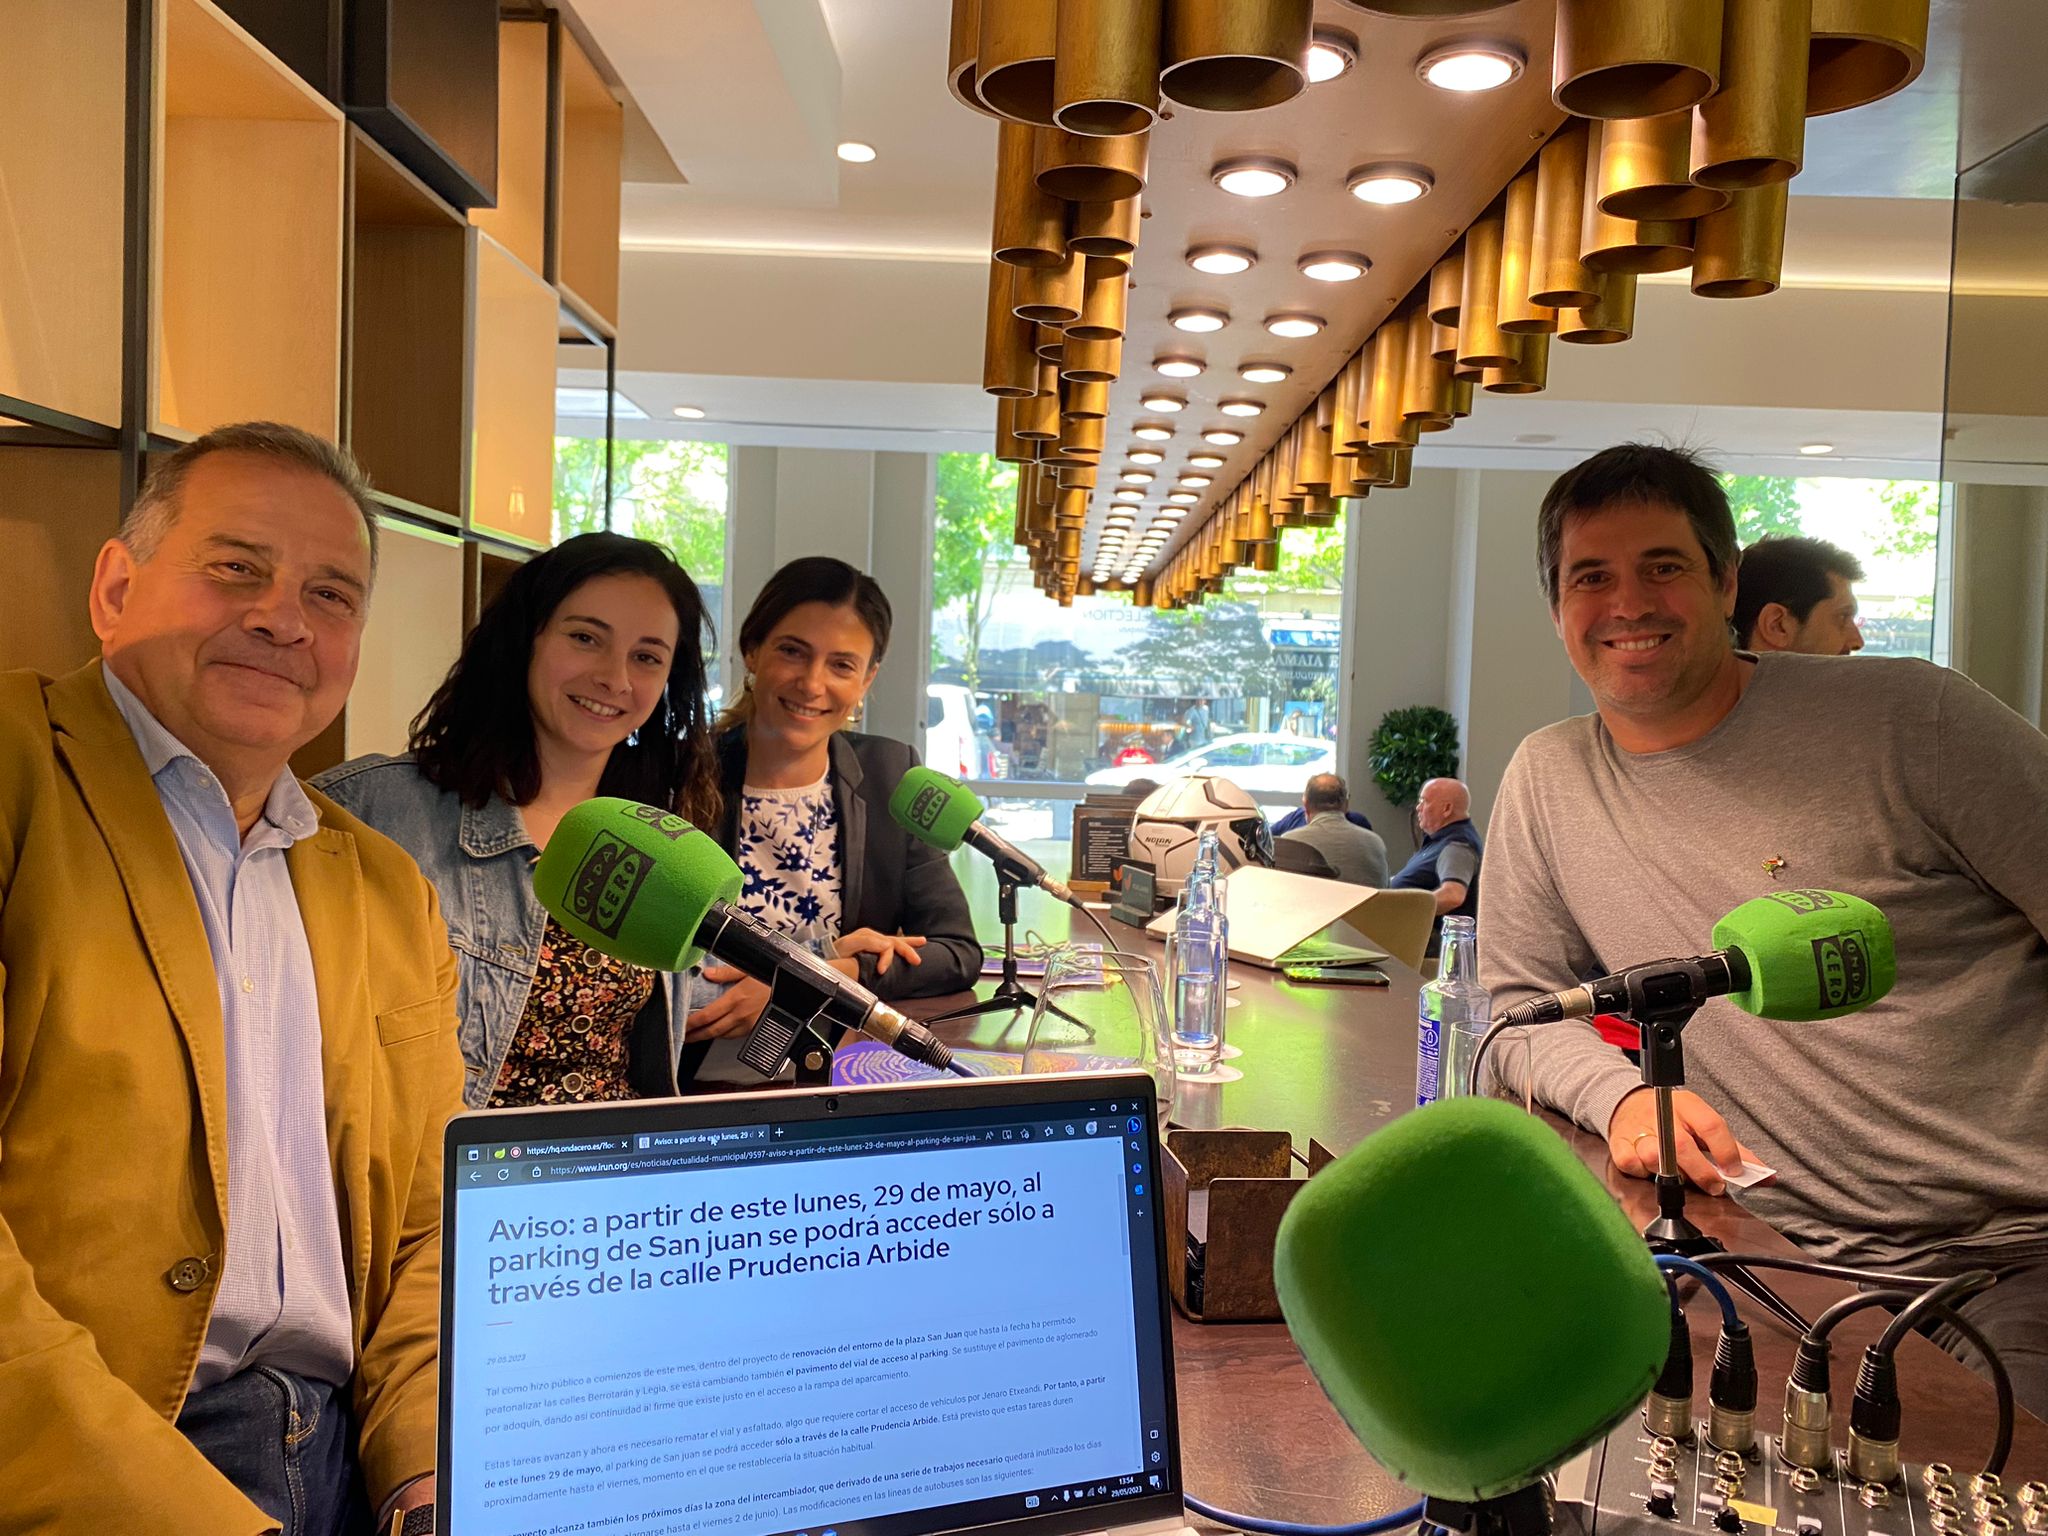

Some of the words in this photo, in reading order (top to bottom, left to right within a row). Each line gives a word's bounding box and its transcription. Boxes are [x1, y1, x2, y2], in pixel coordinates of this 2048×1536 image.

[1274, 653, 1323, 667] AMAIA
[912, 789, 932, 818] ONDA
[924, 795, 943, 822] CERO
[1145, 836, 1173, 845] NOLAN
[577, 850, 612, 909] ONDA
[600, 860, 635, 919] CERO
[1826, 950, 1842, 1002] CERO
[1847, 943, 1861, 996] ONDA
[488, 1215, 574, 1242] Aviso:
[582, 1216, 597, 1233] a
[606, 1204, 683, 1237] partir
[690, 1201, 723, 1223] de
[730, 1197, 787, 1219] este
[794, 1193, 866, 1214] lunes,
[874, 1184, 903, 1206] 29
[910, 1181, 940, 1202] de
[946, 1179, 1016, 1202] mayo,
[1022, 1171, 1040, 1192] al
[489, 1243, 598, 1280] parking
[606, 1238, 642, 1261] de
[648, 1235, 699, 1257] San
[707, 1230, 761, 1258] juan
[768, 1228, 797, 1246] se
[804, 1213, 879, 1248] podrá
[885, 1207, 982, 1234] acceder
[988, 1201, 1036, 1224] sólo
[1041, 1203, 1054, 1218] a
[487, 1274, 580, 1304] través
[587, 1271, 622, 1294] de
[630, 1268, 652, 1290] la
[659, 1260, 721, 1286] calle
[728, 1248, 860, 1279] Prudencia
[866, 1238, 950, 1265] Arbide
[698, 1360, 726, 1370] dentro
[727, 1357, 740, 1367] del
[742, 1353, 778, 1366] proyecto
[779, 1351, 790, 1360] de
[792, 1346, 836, 1358] renovación
[837, 1343, 850, 1352] del
[852, 1341, 882, 1350] entorno
[884, 1339, 894, 1347] de
[895, 1337, 903, 1345] la
[904, 1335, 925, 1346] plaza
[943, 1331, 962, 1339] Juan
[963, 1329, 978, 1338] que
[978, 1326, 1000, 1334] hasta
[1000, 1324, 1008, 1332] la
[1009, 1322, 1030, 1331] fecha
[1031, 1320, 1040, 1328] ha
[1041, 1316, 1076, 1328] permitido
[786, 1367, 793, 1376] el
[795, 1363, 838, 1376] pavimento
[839, 1360, 852, 1369] del
[853, 1358, 868, 1367] vial
[869, 1357, 879, 1365] de
[880, 1354, 908, 1364] acceso
[910, 1351, 918, 1360] al
[951, 1346, 962, 1355] Se
[963, 1343, 996, 1353] sustituye
[998, 1340, 1004, 1349] el
[1006, 1337, 1045, 1350] pavimento
[1044, 1333, 1054, 1343] de
[757, 1387, 764, 1397] el
[766, 1385, 796, 1396] acceso
[804, 1382, 812, 1390] la
[813, 1380, 840, 1389] rampa
[840, 1376, 854, 1385] del
[855, 1370, 910, 1384] aparcamiento.
[785, 1418, 803, 1428] algo
[804, 1416, 820, 1425] que
[821, 1411, 854, 1422] requiere
[855, 1408, 879, 1417] cortar
[880, 1405, 888, 1414] el
[890, 1402, 918, 1413] acceso
[918, 1400, 929, 1408] de
[967, 1394, 980, 1403] por
[981, 1390, 1008, 1400] Jenaro
[1043, 1383, 1056, 1391] Por
[1057, 1380, 1078, 1389] tanto,
[1085, 1375, 1105, 1386] partir
[484, 1480, 495, 1489] de
[498, 1477, 518, 1486] este
[521, 1473, 545, 1483] lunes
[548, 1470, 560, 1479] 29
[562, 1468, 574, 1477] de
[576, 1465, 602, 1476] mayo,
[775, 1436, 793, 1446] sólo
[802, 1431, 827, 1442] través
[828, 1430, 839, 1438] de
[840, 1428, 848, 1436] la
[849, 1425, 869, 1435] calle
[870, 1419, 910, 1432] Prudencia
[912, 1415, 939, 1426] Arbide.
[941, 1412, 958, 1422] Está
[960, 1409, 990, 1421] previsto
[991, 1407, 1006, 1416] que
[1006, 1403, 1027, 1412] estas
[1028, 1400, 1051, 1409] tareas
[1051, 1397, 1073, 1406] duren
[550, 1523, 584, 1534] alcanza
[587, 1516, 624, 1528] también
[626, 1513, 639, 1522] los
[641, 1507, 682, 1521] próximos
[684, 1503, 702, 1512] días
[704, 1501, 712, 1509] la
[715, 1499, 735, 1508] zona
[737, 1494, 750, 1504] del
[752, 1485, 816, 1502] intercambiador,
[818, 1483, 834, 1492] que
[835, 1476, 870, 1488] derivado
[872, 1474, 882, 1483] de
[884, 1473, 898, 1481] una
[900, 1468, 920, 1478] serie
[921, 1466, 931, 1475] de
[933, 1462, 964, 1473] trabajos
[966, 1455, 1003, 1468] necesario
[1004, 1450, 1034, 1463] quedará
[1073, 1443, 1085, 1451] los
[1086, 1440, 1102, 1449] días
[1630, 1491, 1648, 1500] GAIN
[1776, 1526, 1796, 1535] GAIN
